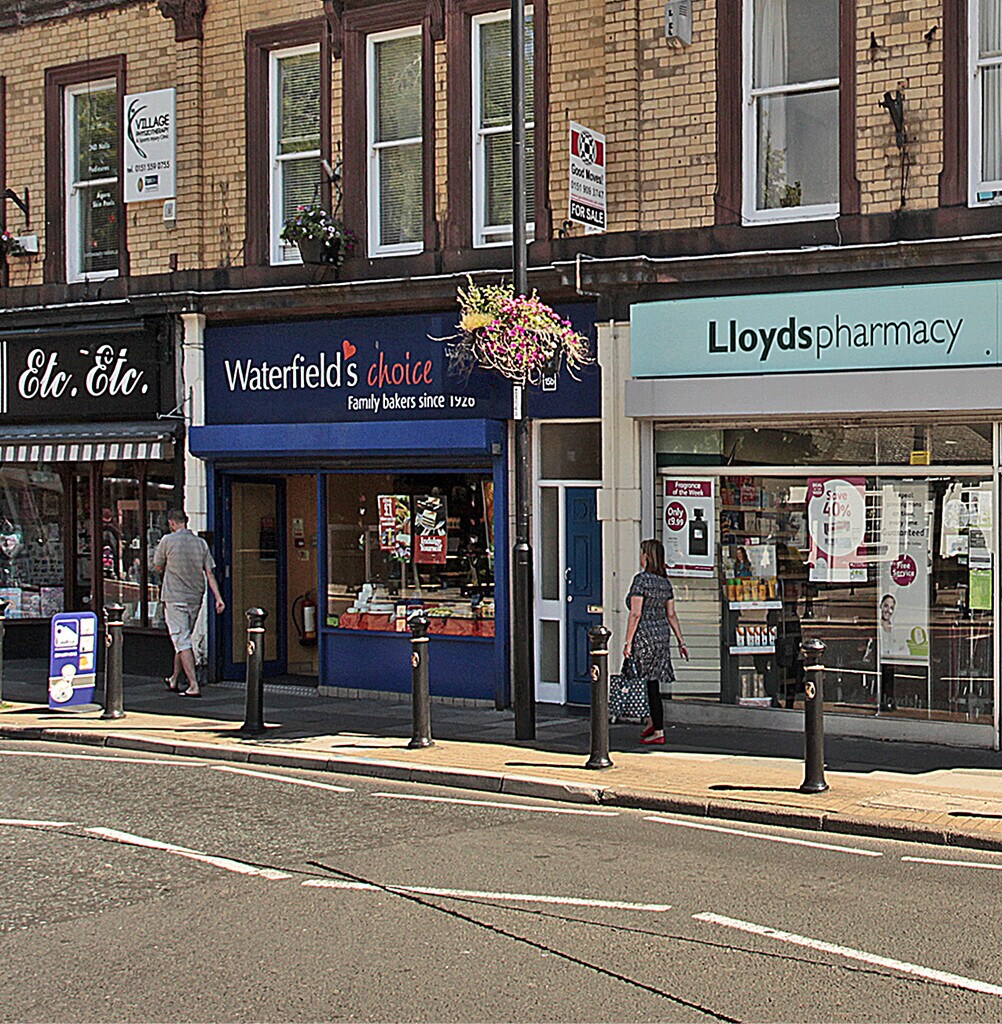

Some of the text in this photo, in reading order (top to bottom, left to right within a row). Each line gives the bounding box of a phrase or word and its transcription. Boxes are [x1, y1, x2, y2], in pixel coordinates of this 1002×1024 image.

[135, 115, 170, 129] VILLAGE
[571, 163, 604, 185] Good Moves!
[571, 203, 604, 224] FOR SALE
[708, 314, 963, 362] Lloydspharmacy
[18, 345, 148, 399] Etc. Etc.
[367, 351, 433, 388] choice
[348, 394, 380, 413] Family
[382, 392, 416, 409] bakers
[418, 392, 445, 408] since
[826, 489, 848, 501] Save
[668, 507, 684, 518] Only
[823, 502, 852, 517] 40%
